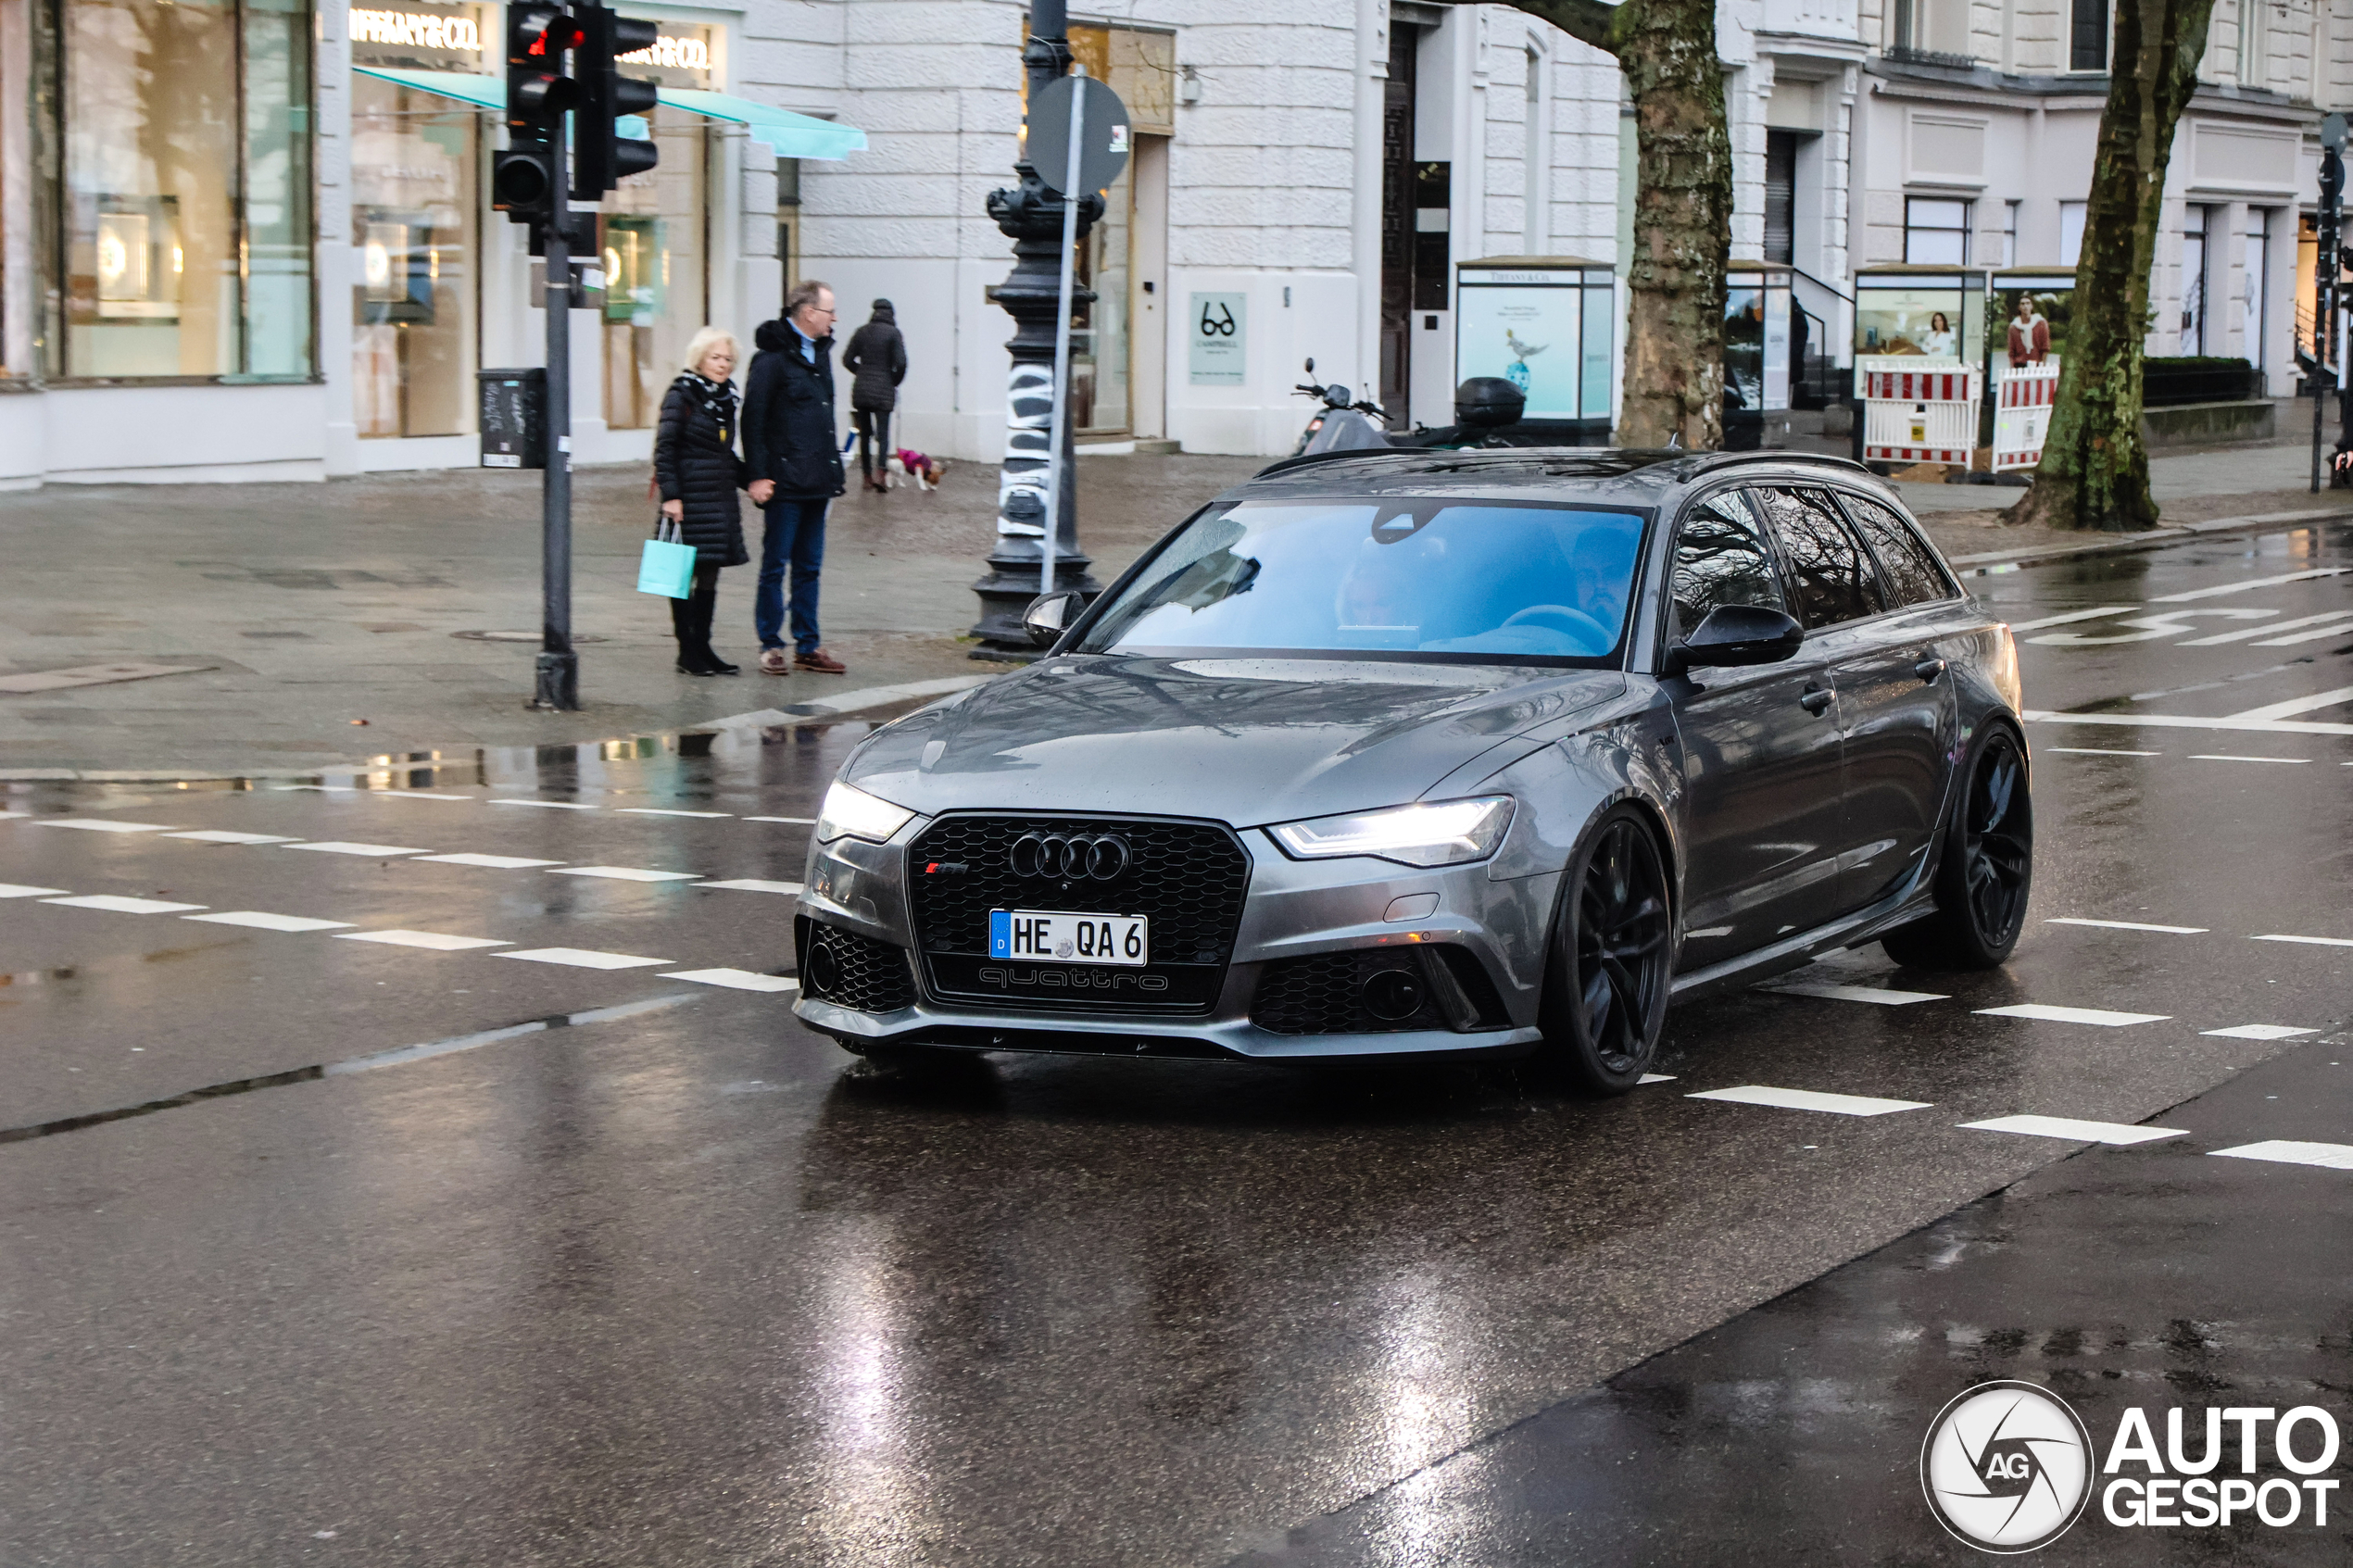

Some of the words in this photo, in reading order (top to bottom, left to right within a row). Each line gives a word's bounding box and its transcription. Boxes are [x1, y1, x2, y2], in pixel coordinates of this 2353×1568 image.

[997, 939, 1005, 949] D
[1014, 918, 1052, 954] HE
[1076, 921, 1114, 958] QA
[1124, 923, 1141, 959] 6
[978, 967, 1168, 991] quattro
